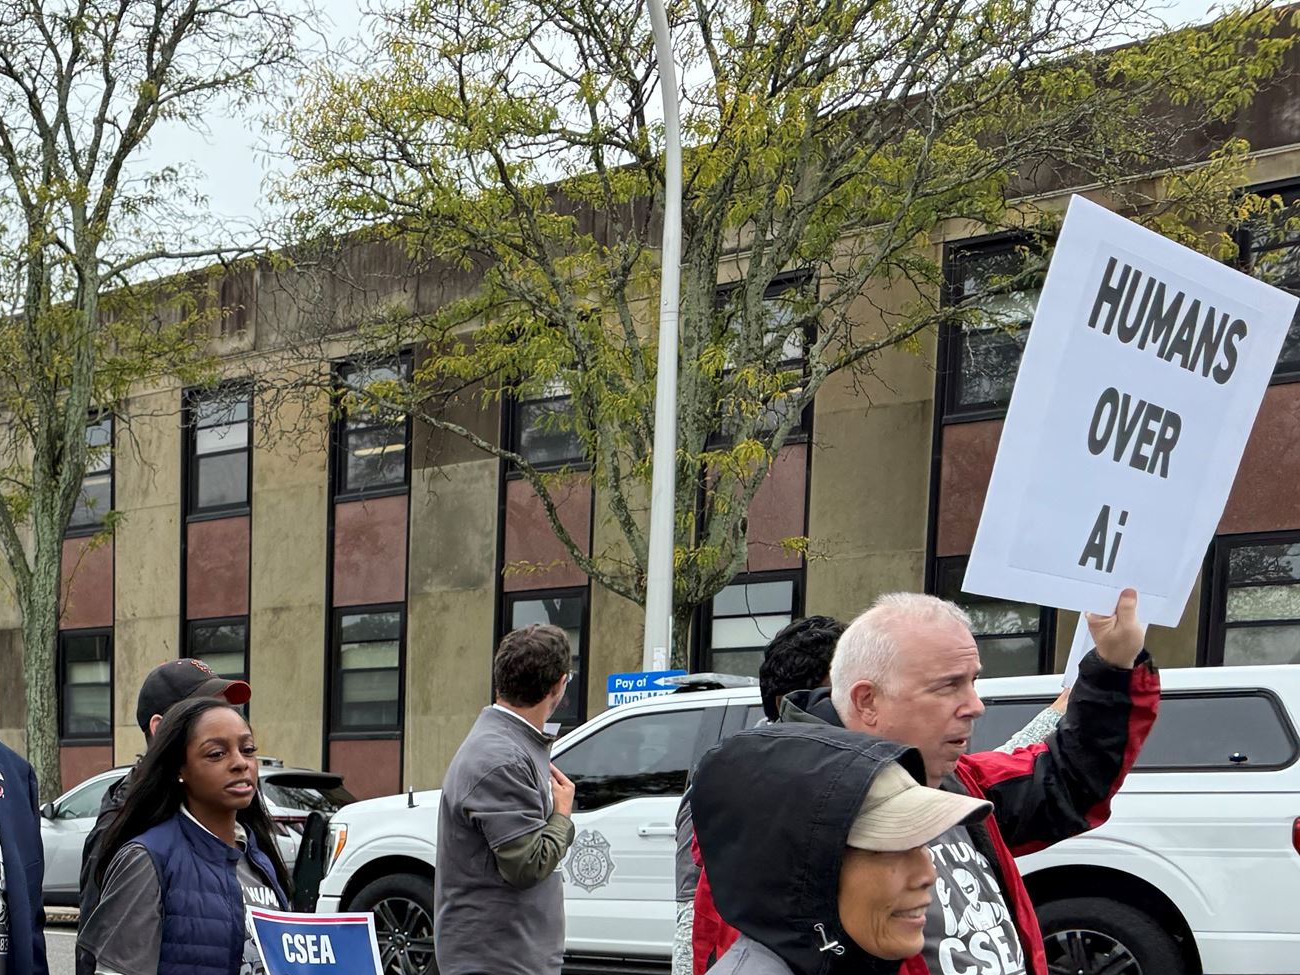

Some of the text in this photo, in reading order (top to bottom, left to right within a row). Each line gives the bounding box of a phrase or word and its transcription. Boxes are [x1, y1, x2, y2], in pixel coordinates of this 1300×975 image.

[1087, 256, 1248, 385] HUMANS
[1086, 386, 1183, 479] OVER
[1078, 504, 1129, 574] Ai
[615, 679, 634, 690] Pay
[281, 933, 336, 964] CSEA
